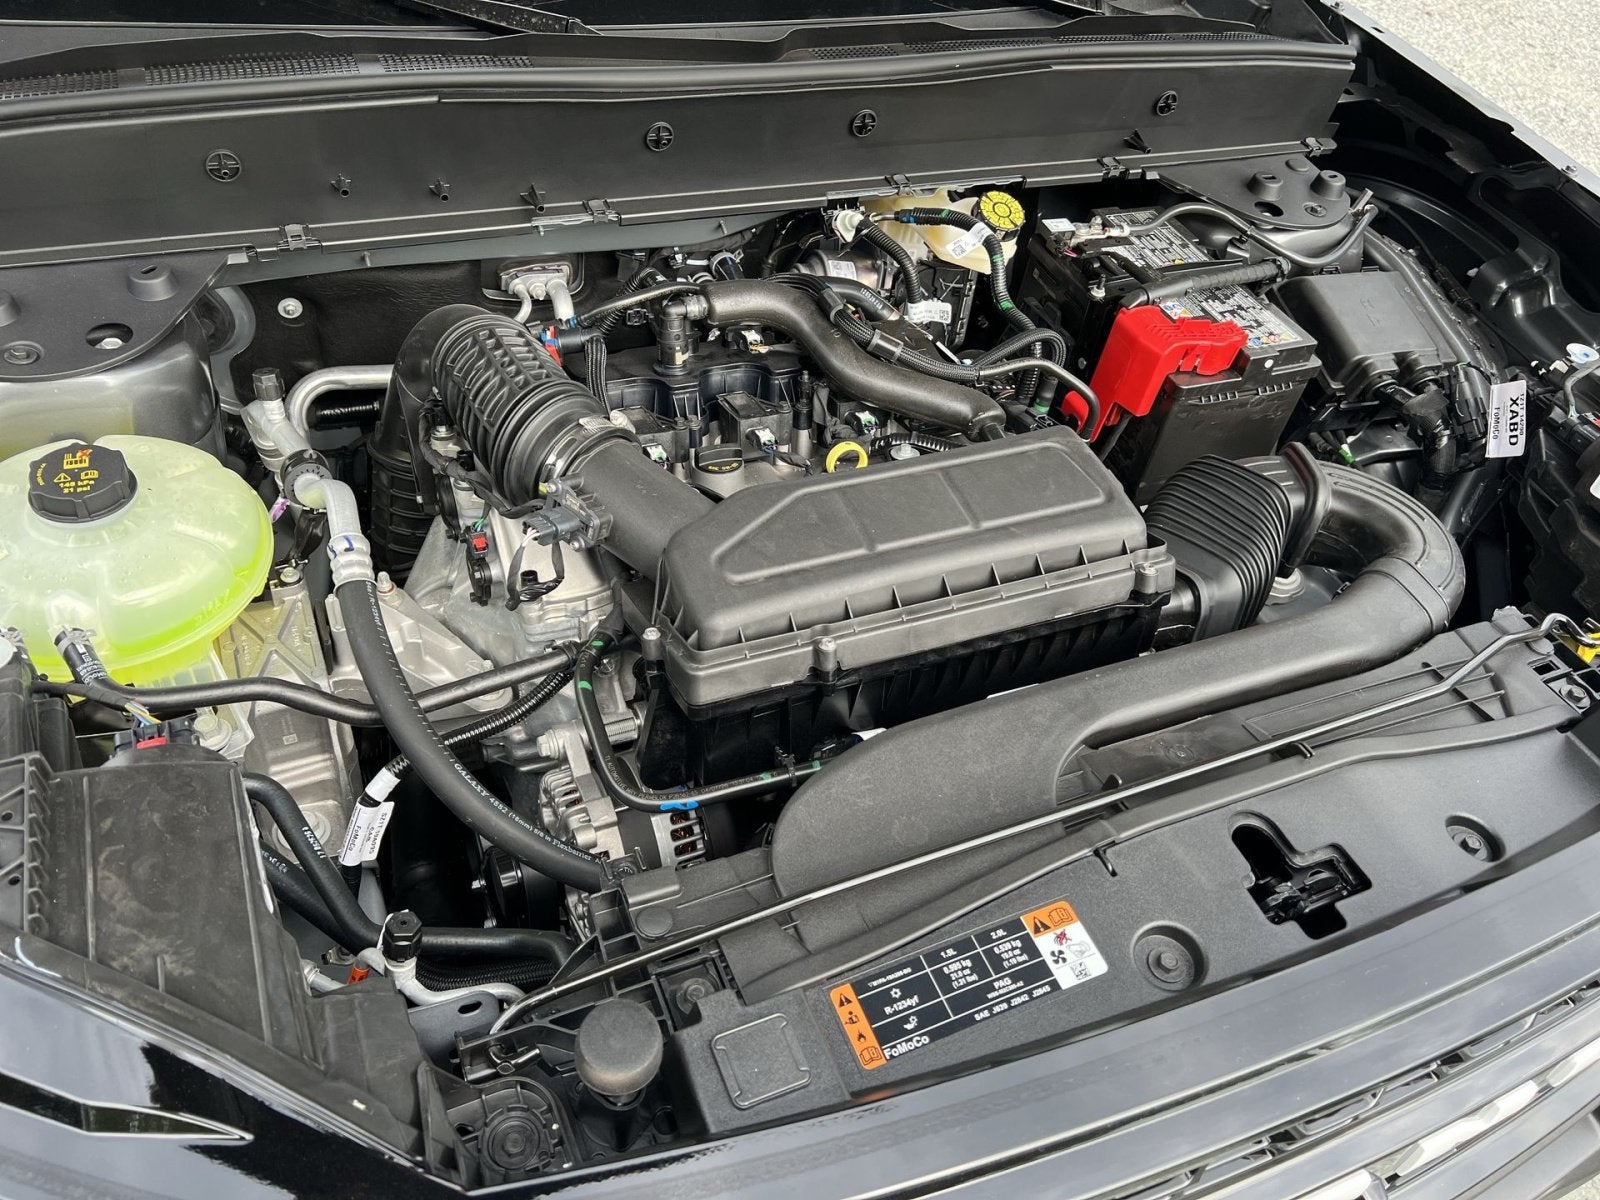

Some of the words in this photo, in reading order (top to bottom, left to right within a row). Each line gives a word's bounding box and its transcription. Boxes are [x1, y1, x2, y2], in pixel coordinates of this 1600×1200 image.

[1509, 397, 1519, 446] XABD
[454, 763, 490, 797] GALAXY
[552, 837, 592, 861] Flexbarrier
[1010, 938, 1022, 951] kg
[960, 957, 972, 971] kg
[993, 977, 1012, 990] PAG
[884, 994, 920, 1016] R-1234yf
[974, 1008, 991, 1022] SAE
[883, 1033, 931, 1060] FoMoCo
